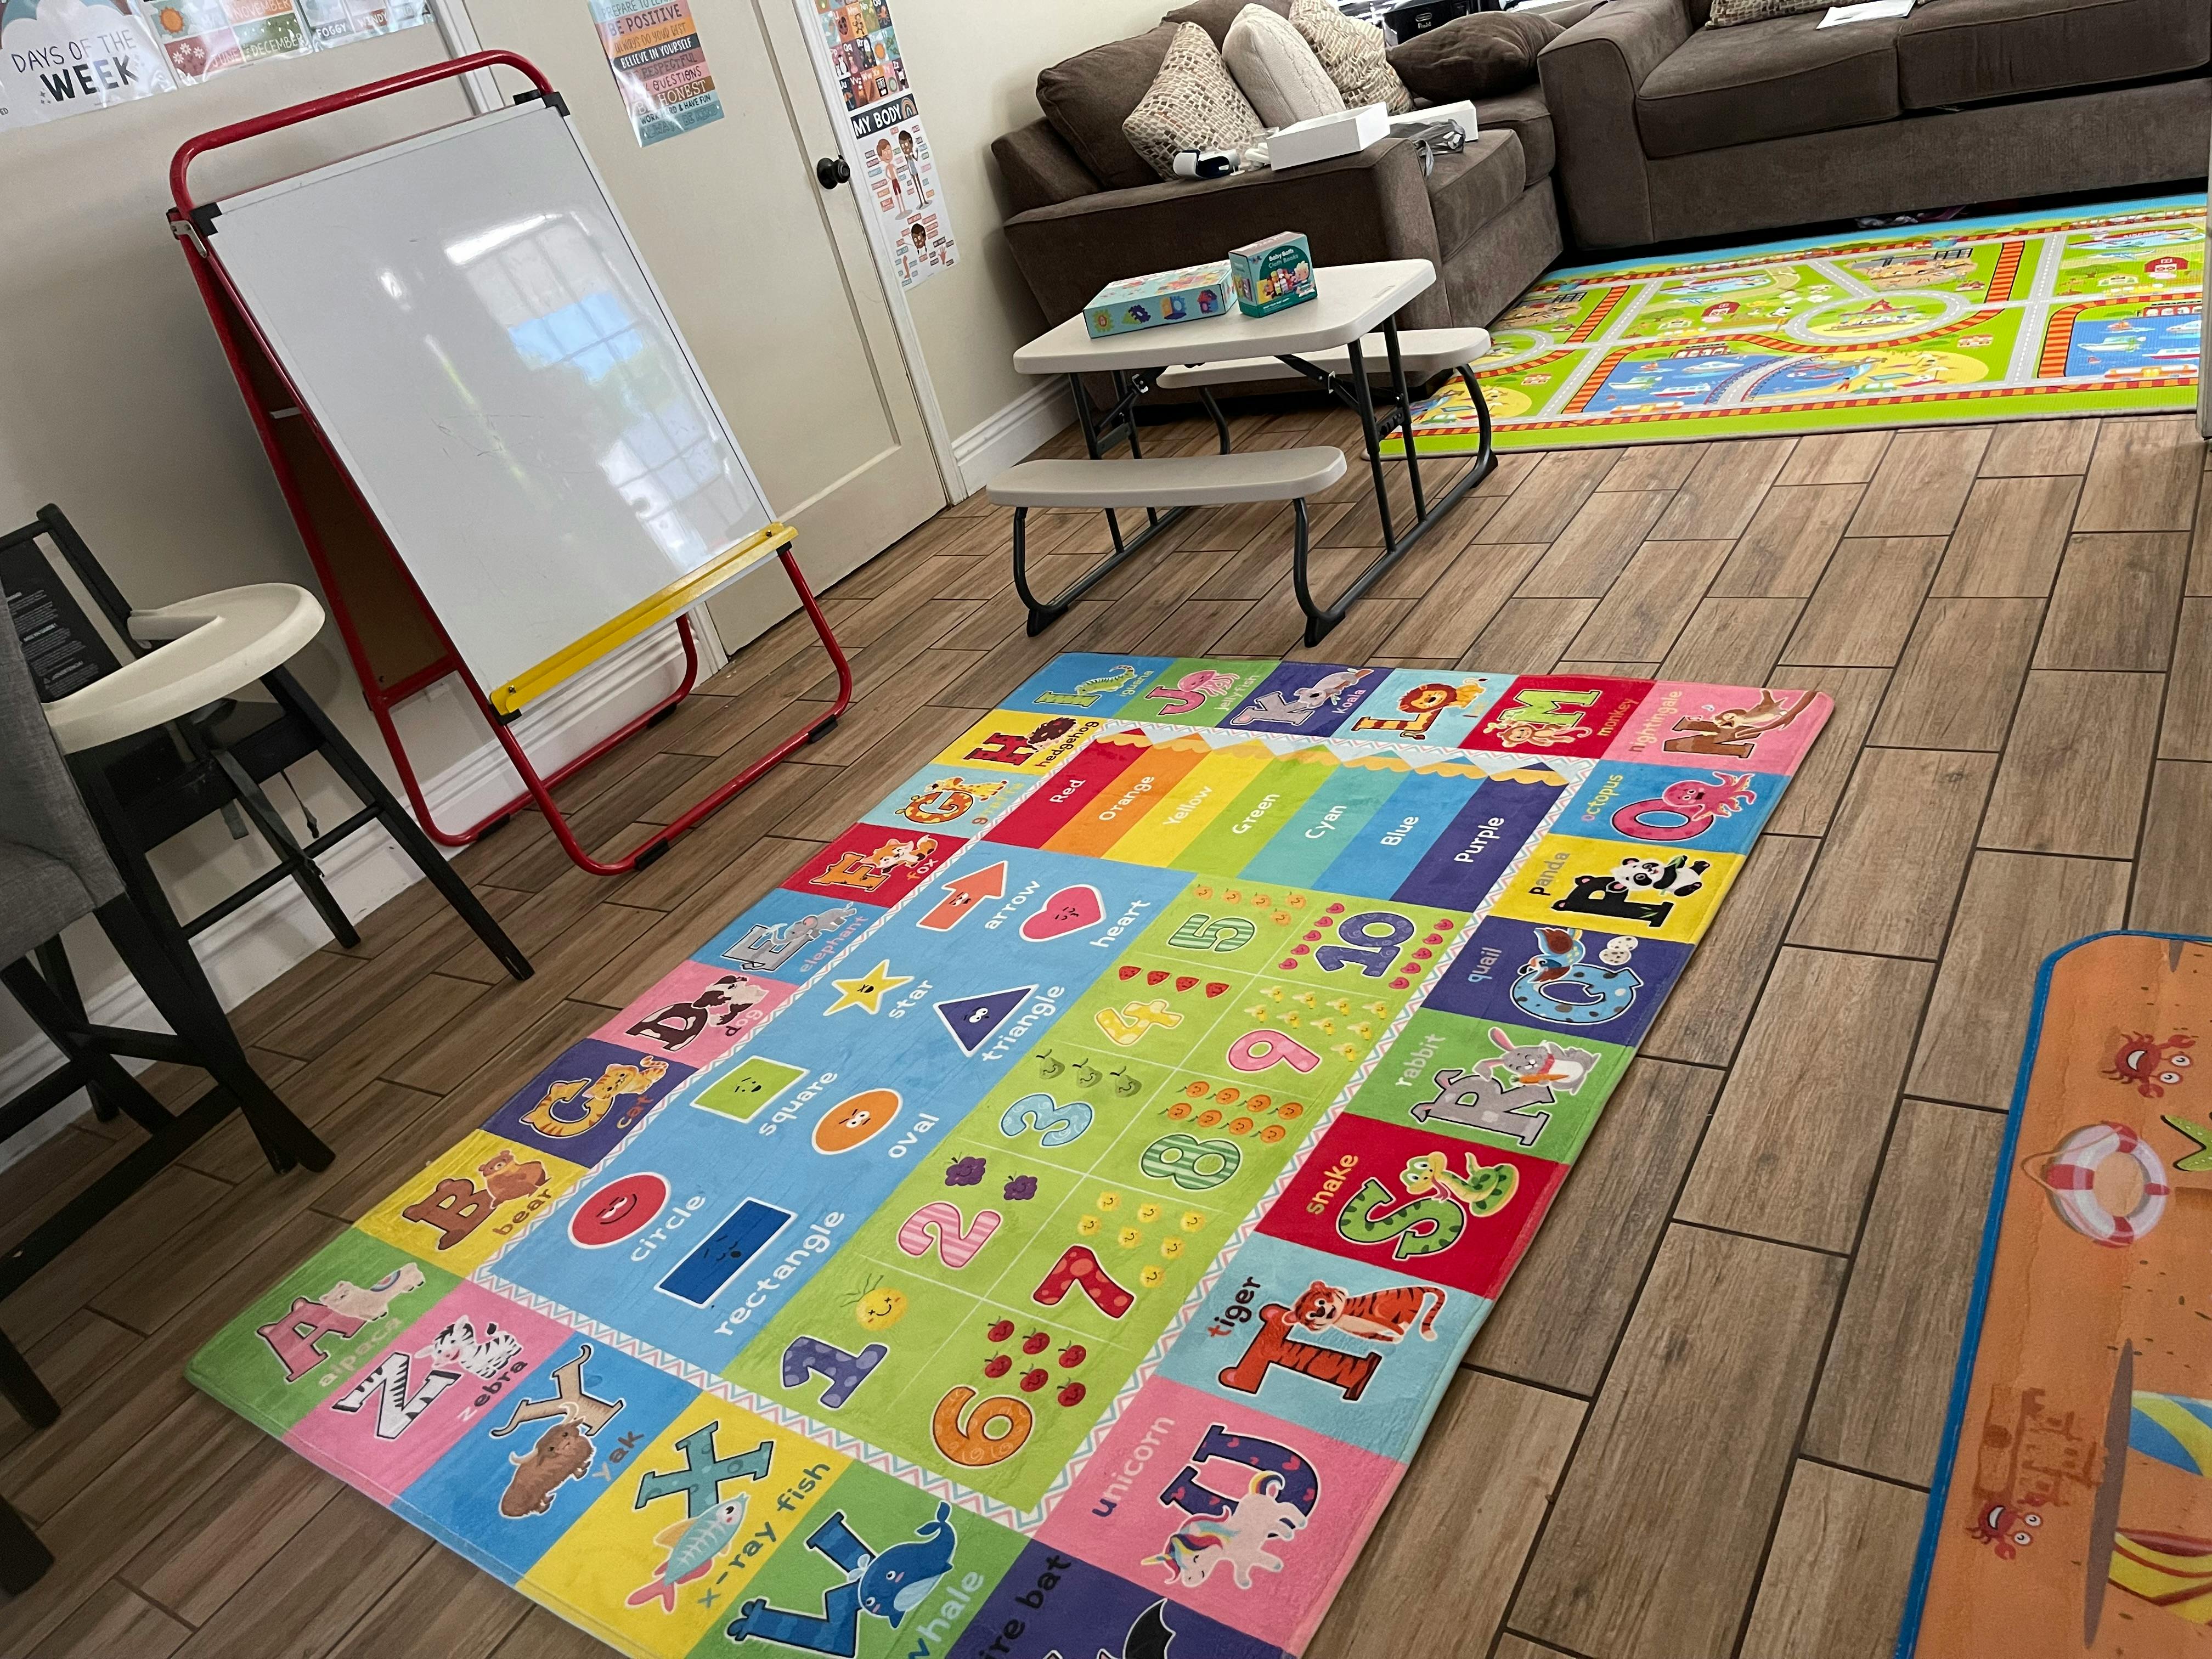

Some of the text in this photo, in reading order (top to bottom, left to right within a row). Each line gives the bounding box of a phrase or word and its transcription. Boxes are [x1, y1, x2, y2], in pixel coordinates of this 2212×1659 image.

[316, 22, 348, 38] FOGGY
[602, 3, 638, 19] PREPARE
[607, 4, 682, 36] BE POSITIVE
[641, 33, 651, 44] DO
[652, 27, 670, 41] YOUR
[671, 22, 686, 36] BEST
[11, 30, 136, 73] DAYS OF THE
[212, 48, 239, 67] JUNE
[251, 33, 303, 57] DECEMBER
[620, 37, 692, 69] BELIEVE IN YOURSELF
[642, 53, 697, 79] RESPECTFUL
[40, 55, 139, 102] WEEK
[653, 65, 702, 92] QUESTIONS
[657, 80, 706, 106] HONEST
[685, 98, 700, 110] HAVE
[700, 94, 712, 104] FUN
[853, 104, 902, 136] MY BODY
[1268, 249, 1294, 262] Baby Bath
[1033, 690, 1101, 708] I
[1119, 669, 1154, 697] iguana
[1146, 684, 1206, 717] J
[1332, 689, 1366, 714] koala
[1231, 690, 1314, 726] K
[1351, 707, 1444, 735] L
[1500, 688, 1601, 727] M
[1596, 697, 1639, 737] monkey
[1629, 688, 1683, 753] nightingale
[963, 732, 1037, 766] H
[1035, 720, 1099, 767] hedgehog
[1663, 717, 1761, 759] N
[904, 790, 974, 824] G
[1049, 778, 1086, 803] Red
[1098, 775, 1155, 821] Orange
[1164, 785, 1212, 826] Yellow
[1232, 793, 1280, 834] Green
[1581, 771, 1624, 822] octopus
[1304, 804, 1347, 839] Cyan
[1380, 816, 1419, 846] Blue
[1454, 816, 1505, 864] Purple
[1612, 798, 1715, 840] O
[810, 853, 890, 892] F
[906, 858, 939, 881] fox
[1528, 852, 1570, 895] panda
[985, 881, 1040, 930] arrow
[1089, 900, 1152, 947] heart
[1551, 875, 1674, 928] P
[721, 925, 815, 971] E
[799, 916, 868, 973] elephant
[1167, 914, 1256, 952] 5
[1315, 912, 1415, 978] 10
[1468, 947, 1503, 983] quail
[889, 980, 934, 1018] star
[625, 1002, 709, 1052] D
[724, 1009, 764, 1037] dog
[982, 985, 1065, 1063] triangle
[1095, 1000, 1183, 1045] 4
[1227, 1030, 1321, 1074] 9
[1395, 1032, 1446, 1088] rabbit
[519, 1077, 615, 1138] C
[616, 1096, 654, 1130] cat
[758, 1071, 838, 1137] square
[1000, 1093, 1093, 1147] 3
[1412, 1069, 1553, 1147] R
[889, 1112, 939, 1159] oval
[1142, 1135, 1242, 1192] 8
[1306, 1152, 1358, 1216] snake
[403, 1178, 496, 1250] B
[493, 1188, 552, 1235] bear
[630, 1193, 706, 1263] circle
[1337, 1177, 1464, 1260] S
[898, 1201, 1002, 1269] 2
[714, 1210, 845, 1338] rectangle
[1033, 1245, 1135, 1319] 7
[1206, 1275, 1262, 1338] tiger
[256, 1296, 370, 1382] A
[319, 1317, 401, 1386] alpaca
[1218, 1303, 1383, 1402] T
[457, 1361, 527, 1421] zebra
[490, 1345, 624, 1436] Y
[781, 1335, 888, 1409] 1
[331, 1351, 461, 1441] Z
[933, 1386, 1032, 1466] 6
[592, 1431, 645, 1481] yak
[634, 1421, 774, 1522] X
[1091, 1415, 1176, 1518] unicorn
[1159, 1423, 1321, 1530] U
[697, 1461, 831, 1607] x-ray fish
[1015, 1555, 1071, 1610] bat
[909, 1571, 984, 1659] whale
